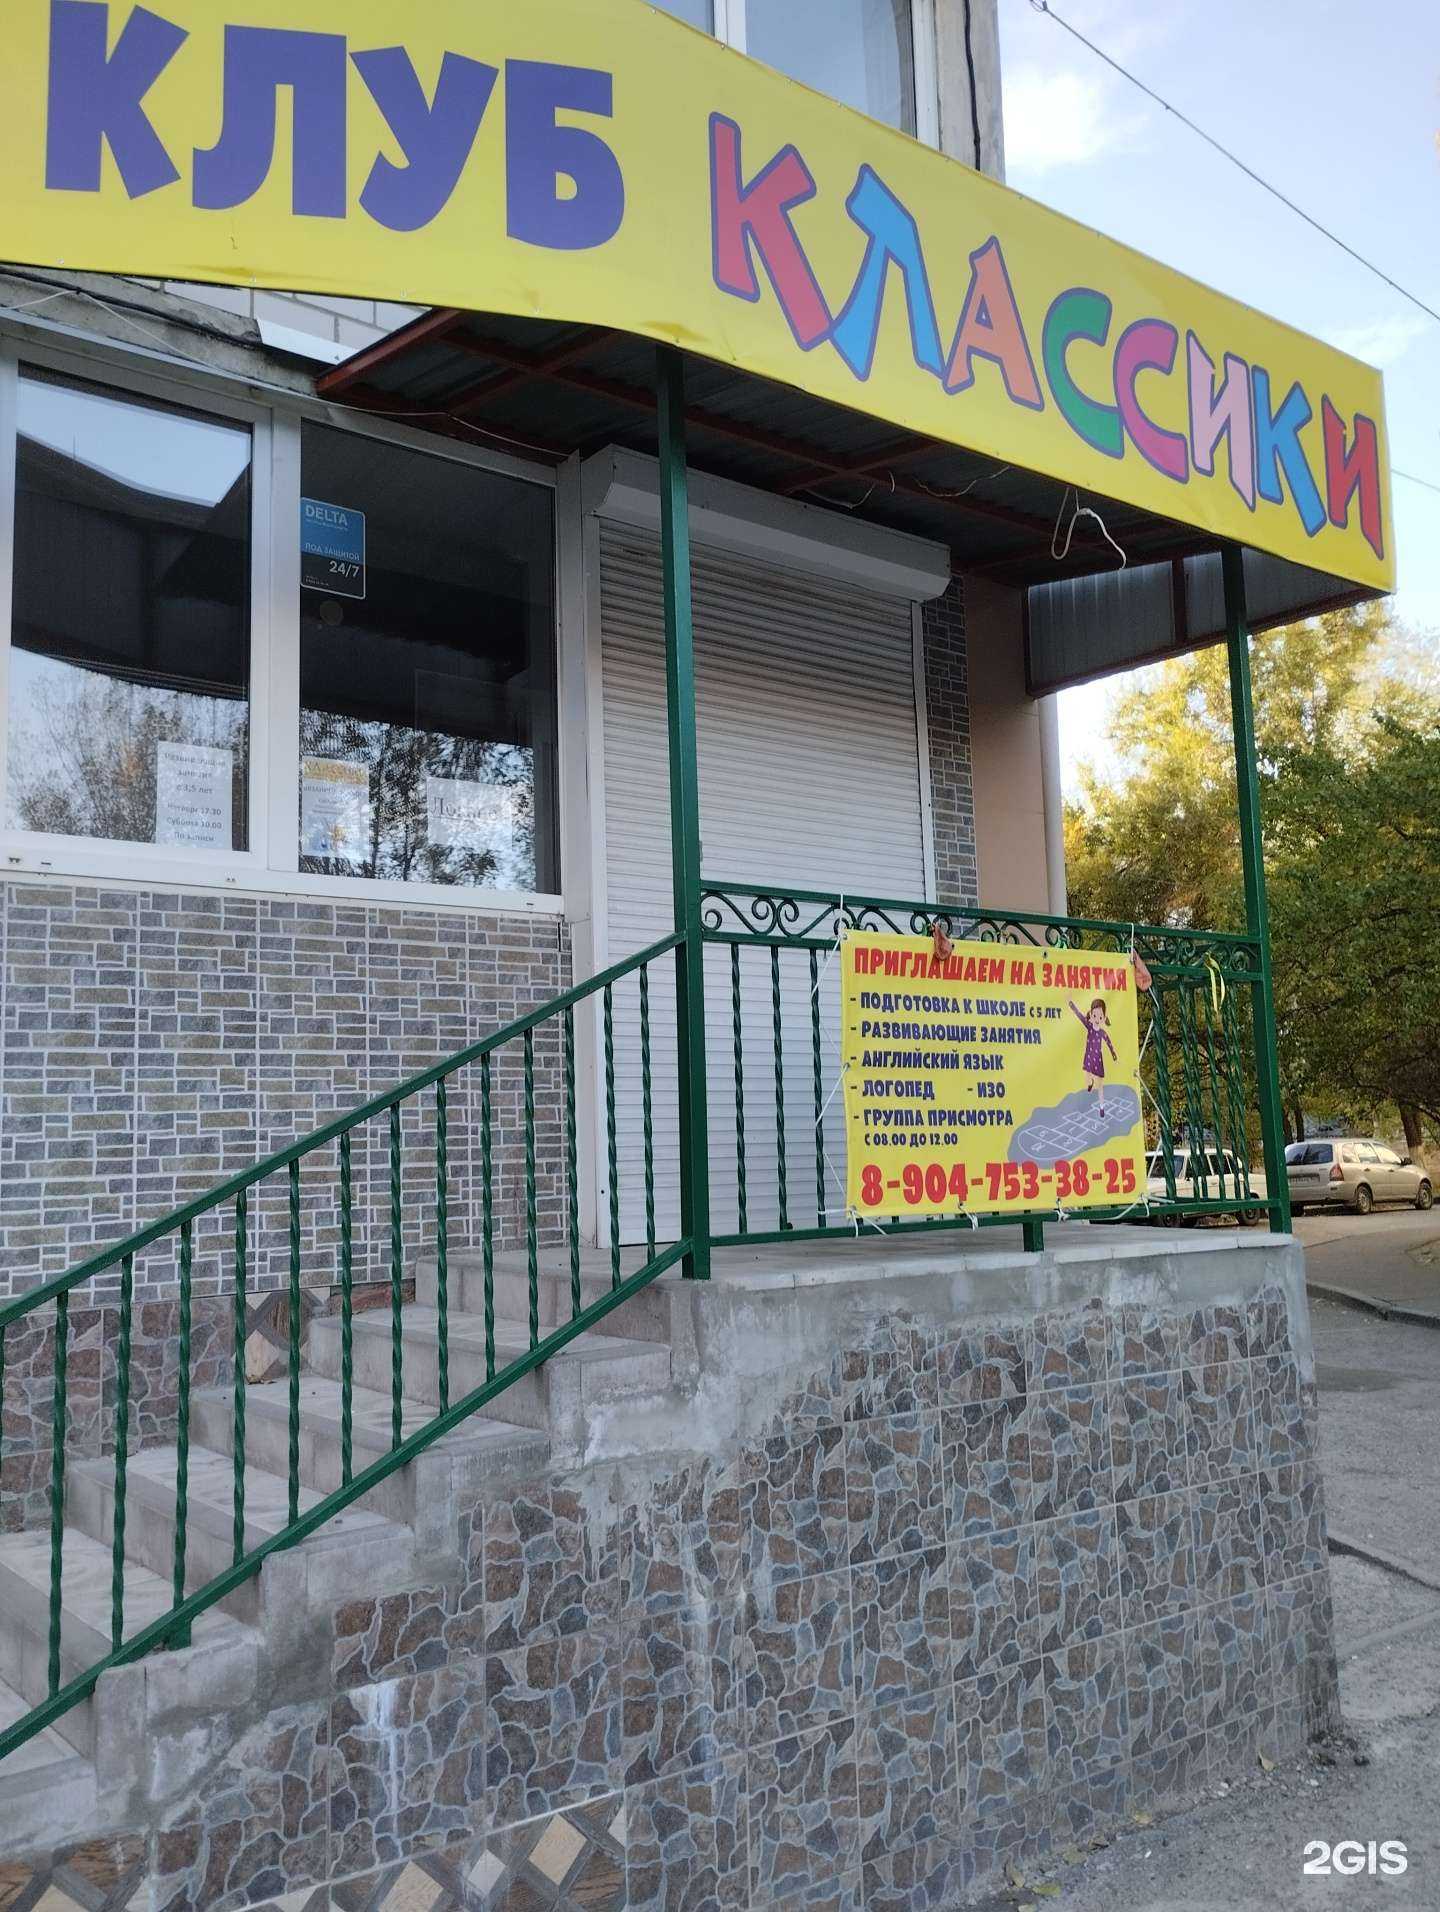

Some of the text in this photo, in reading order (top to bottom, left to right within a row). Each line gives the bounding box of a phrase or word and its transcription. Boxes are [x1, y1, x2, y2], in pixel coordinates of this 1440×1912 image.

[45, 0, 1384, 561] КЛУБ КЛАССИКИ
[305, 504, 348, 526] DELTA
[305, 542, 360, 561] ПОД ЗАЩИТОЙ
[329, 560, 360, 578] 24/7
[854, 947, 1127, 991] ПРИГЛАШАЕМ НА ЗАНЯТИЯ
[860, 991, 960, 1014] ПОДГОТОВКА
[963, 998, 973, 1014] К
[976, 998, 1026, 1017] ШКОЛЕ
[1036, 1006, 1043, 1019] 5
[1044, 1007, 1062, 1019] ЛЕТ
[861, 1020, 977, 1043] РАЗВИВАЮЩИЕ
[981, 1026, 1042, 1045] ЗАНЯТИЯ
[862, 1048, 960, 1070] АНГЛИЙСКИЙ
[963, 1053, 1004, 1071] ЯЗЫК
[862, 1079, 935, 1100] ЛОГОПЕД
[977, 1081, 1006, 1099] ИЗО
[864, 1109, 924, 1127] ГРУППА
[928, 1109, 1013, 1127] ПРИСМОТРА
[873, 1132, 907, 1147] 08.00
[909, 1133, 927, 1148] ДО
[929, 1133, 958, 1146] 12.00
[860, 1157, 1137, 1207] 8-904-753-38-25
